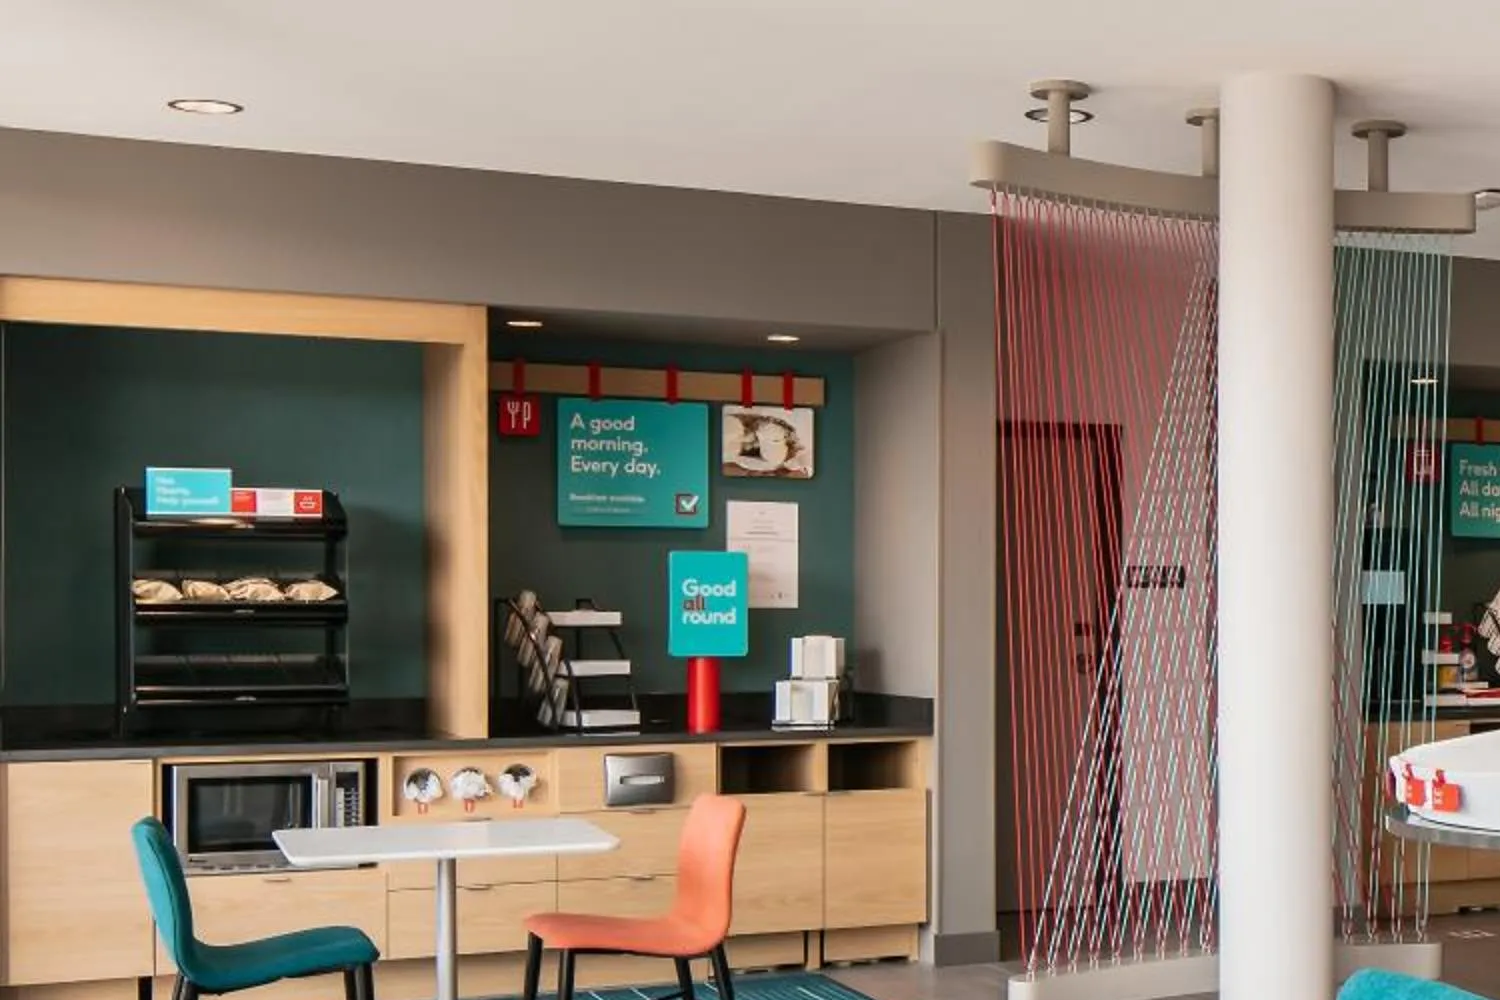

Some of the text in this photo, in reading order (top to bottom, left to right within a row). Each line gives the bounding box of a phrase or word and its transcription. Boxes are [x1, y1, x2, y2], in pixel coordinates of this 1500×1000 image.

[570, 412, 636, 435] A good
[571, 435, 649, 457] morning.
[571, 455, 661, 479] Every day.
[1459, 459, 1497, 477] Fresh
[1459, 480, 1479, 496] All
[1459, 501, 1479, 517] All
[682, 578, 737, 597] Good
[683, 594, 705, 611] all
[682, 607, 737, 625] round
